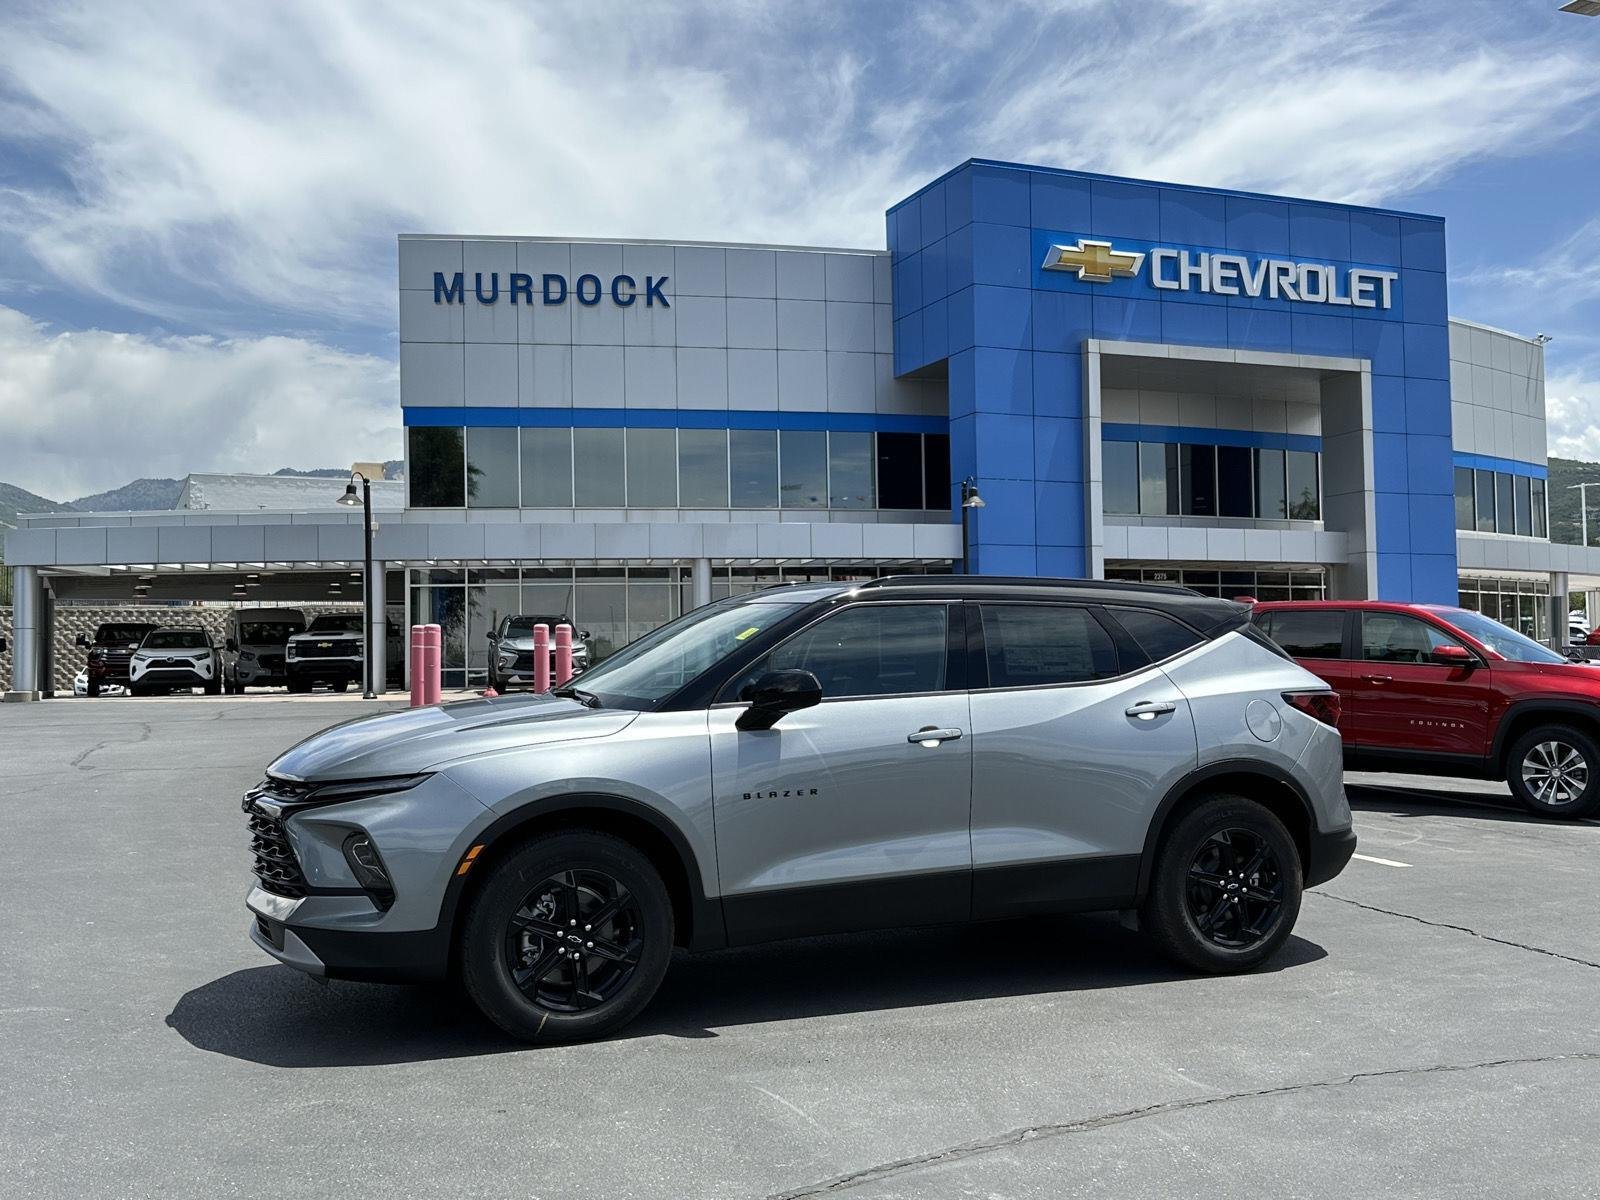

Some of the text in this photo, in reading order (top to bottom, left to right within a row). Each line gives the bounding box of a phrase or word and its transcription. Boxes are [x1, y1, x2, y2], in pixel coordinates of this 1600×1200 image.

[433, 272, 671, 308] MURDOCK
[1150, 247, 1398, 309] CHEVROLET
[1410, 720, 1465, 729] EQUINOX
[743, 788, 819, 800] BLAZER
